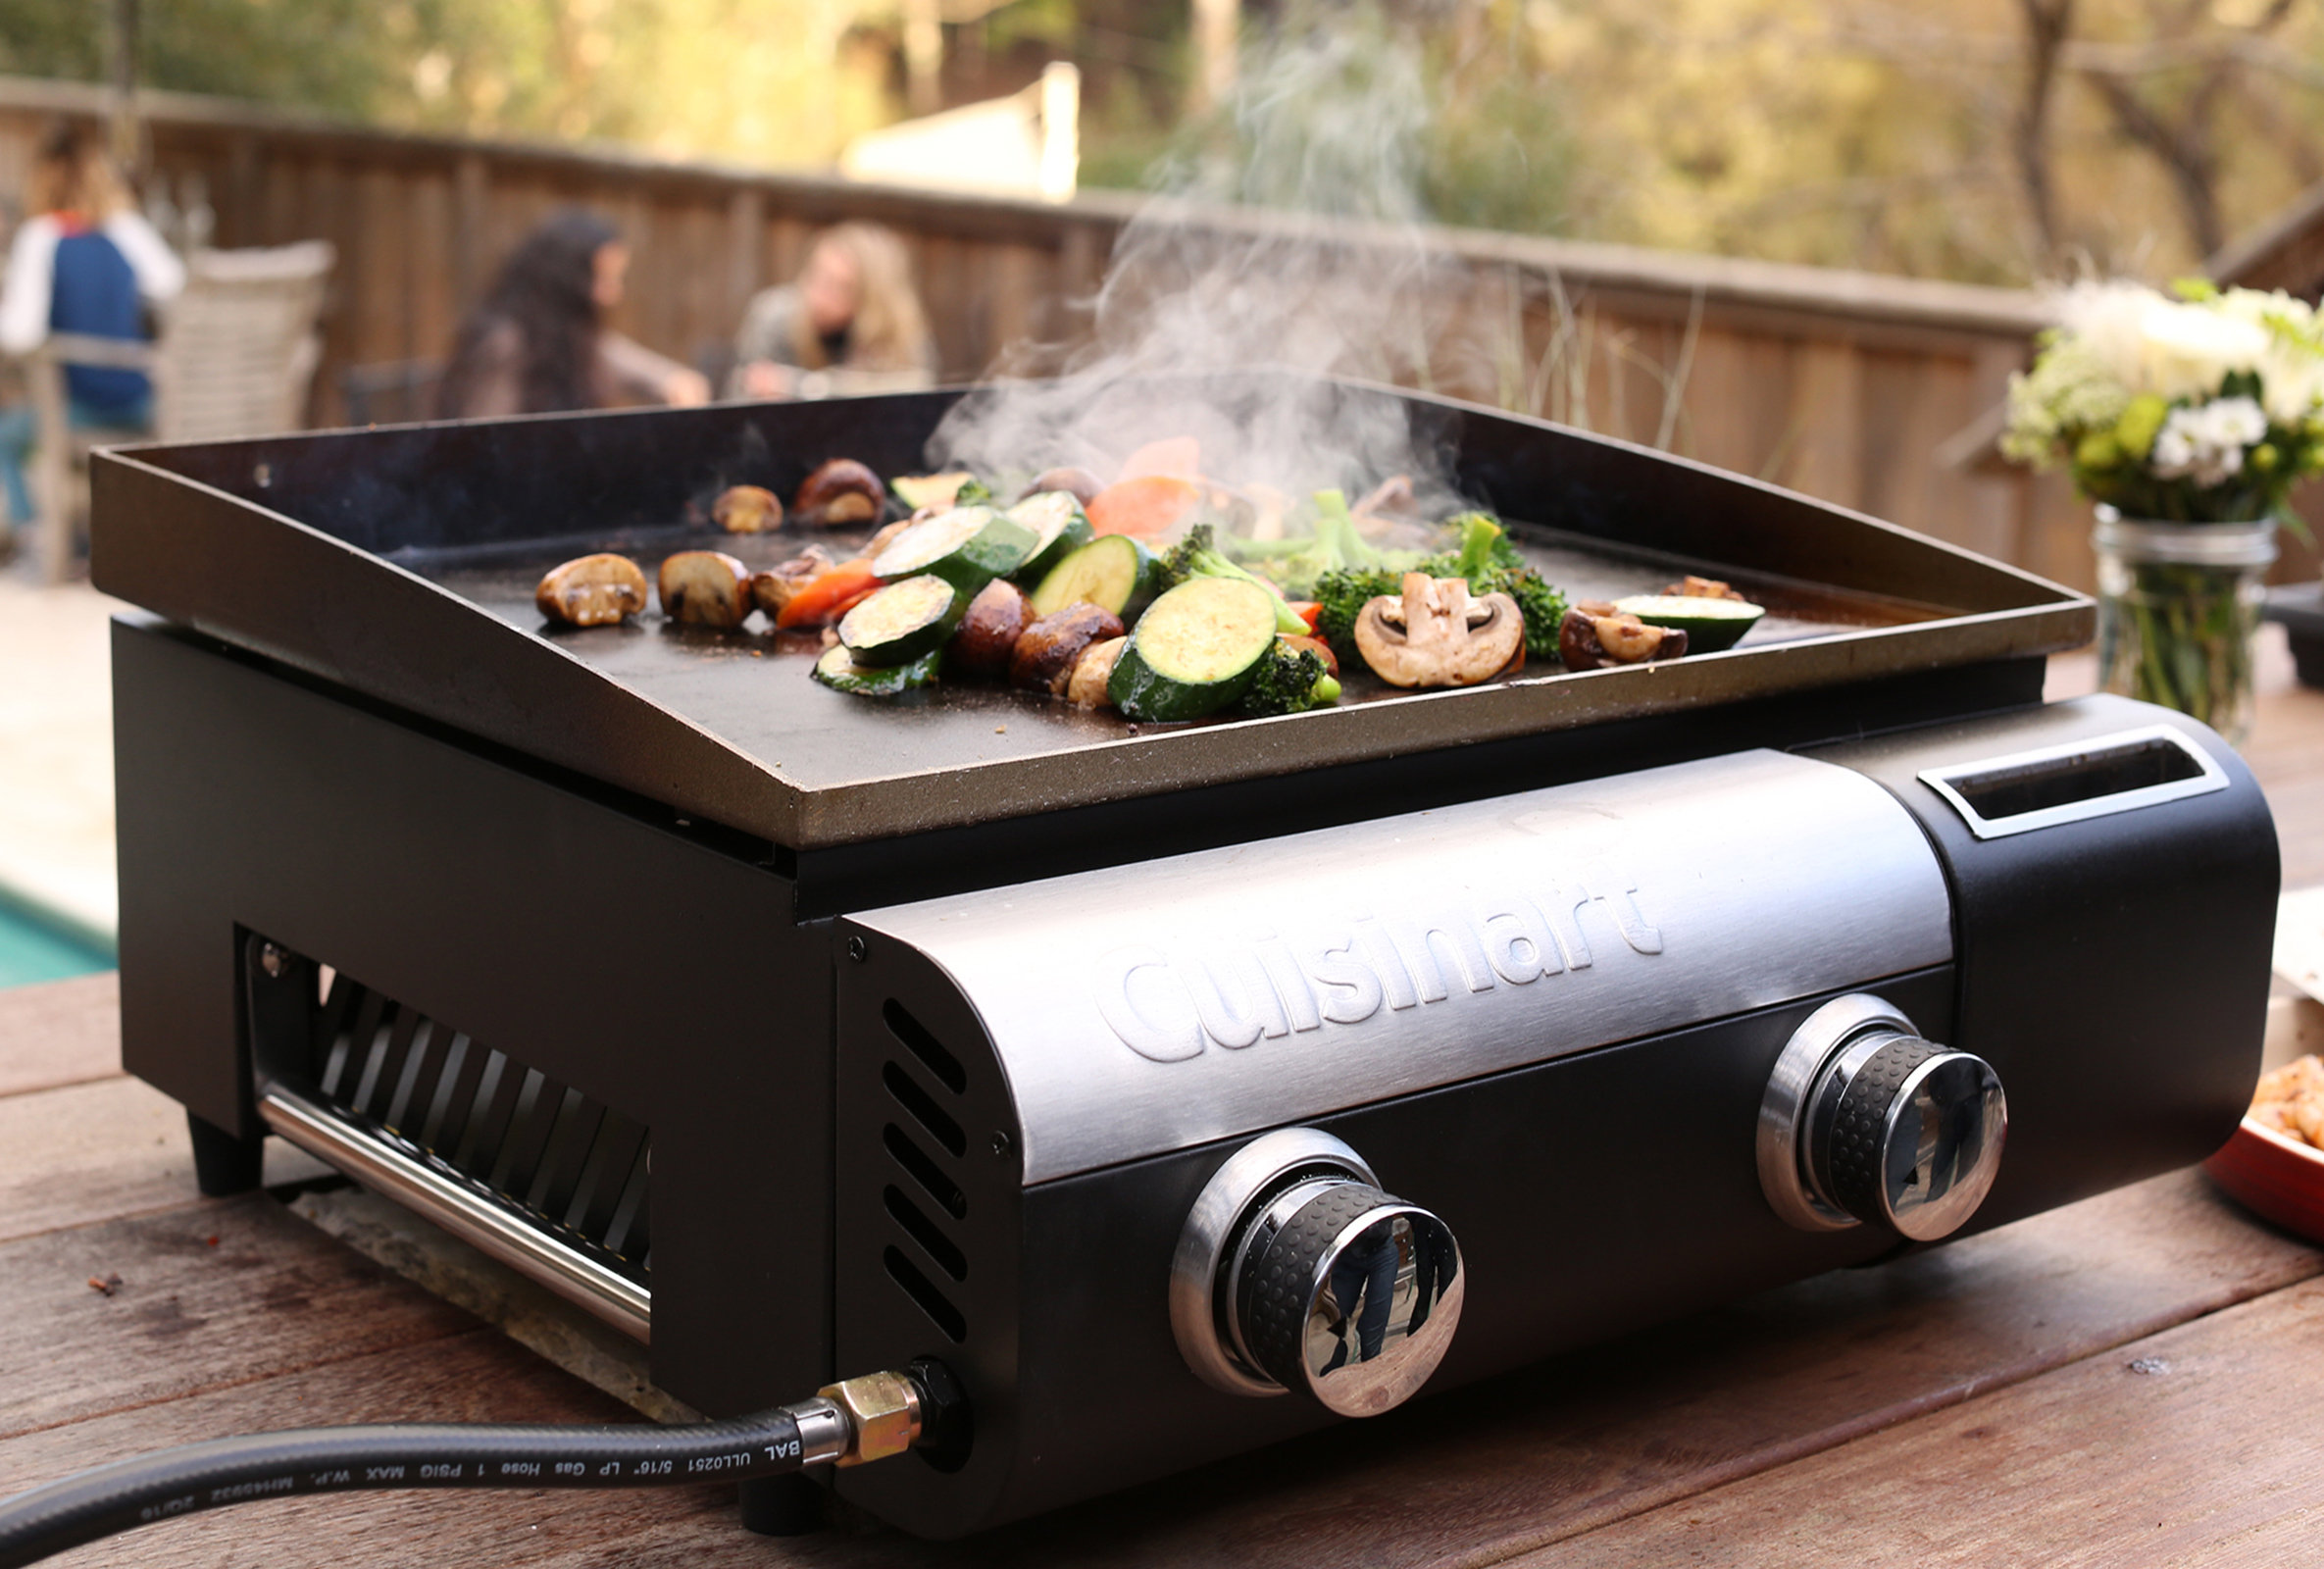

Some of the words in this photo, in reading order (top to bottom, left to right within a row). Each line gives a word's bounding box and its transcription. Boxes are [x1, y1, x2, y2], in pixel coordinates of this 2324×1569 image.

[1091, 859, 1663, 1064] Cuisinart
[765, 1440, 801, 1461] BAL
[478, 1462, 485, 1477] 1
[501, 1461, 540, 1477] Hose
[555, 1461, 585, 1477] Gas
[599, 1461, 621, 1477] LP
[633, 1459, 675, 1475] 5/16"
[687, 1451, 751, 1473] ULL0251
[310, 1470, 351, 1486] W.P.
[366, 1465, 405, 1481] MAX
[419, 1463, 463, 1479] PSIG
